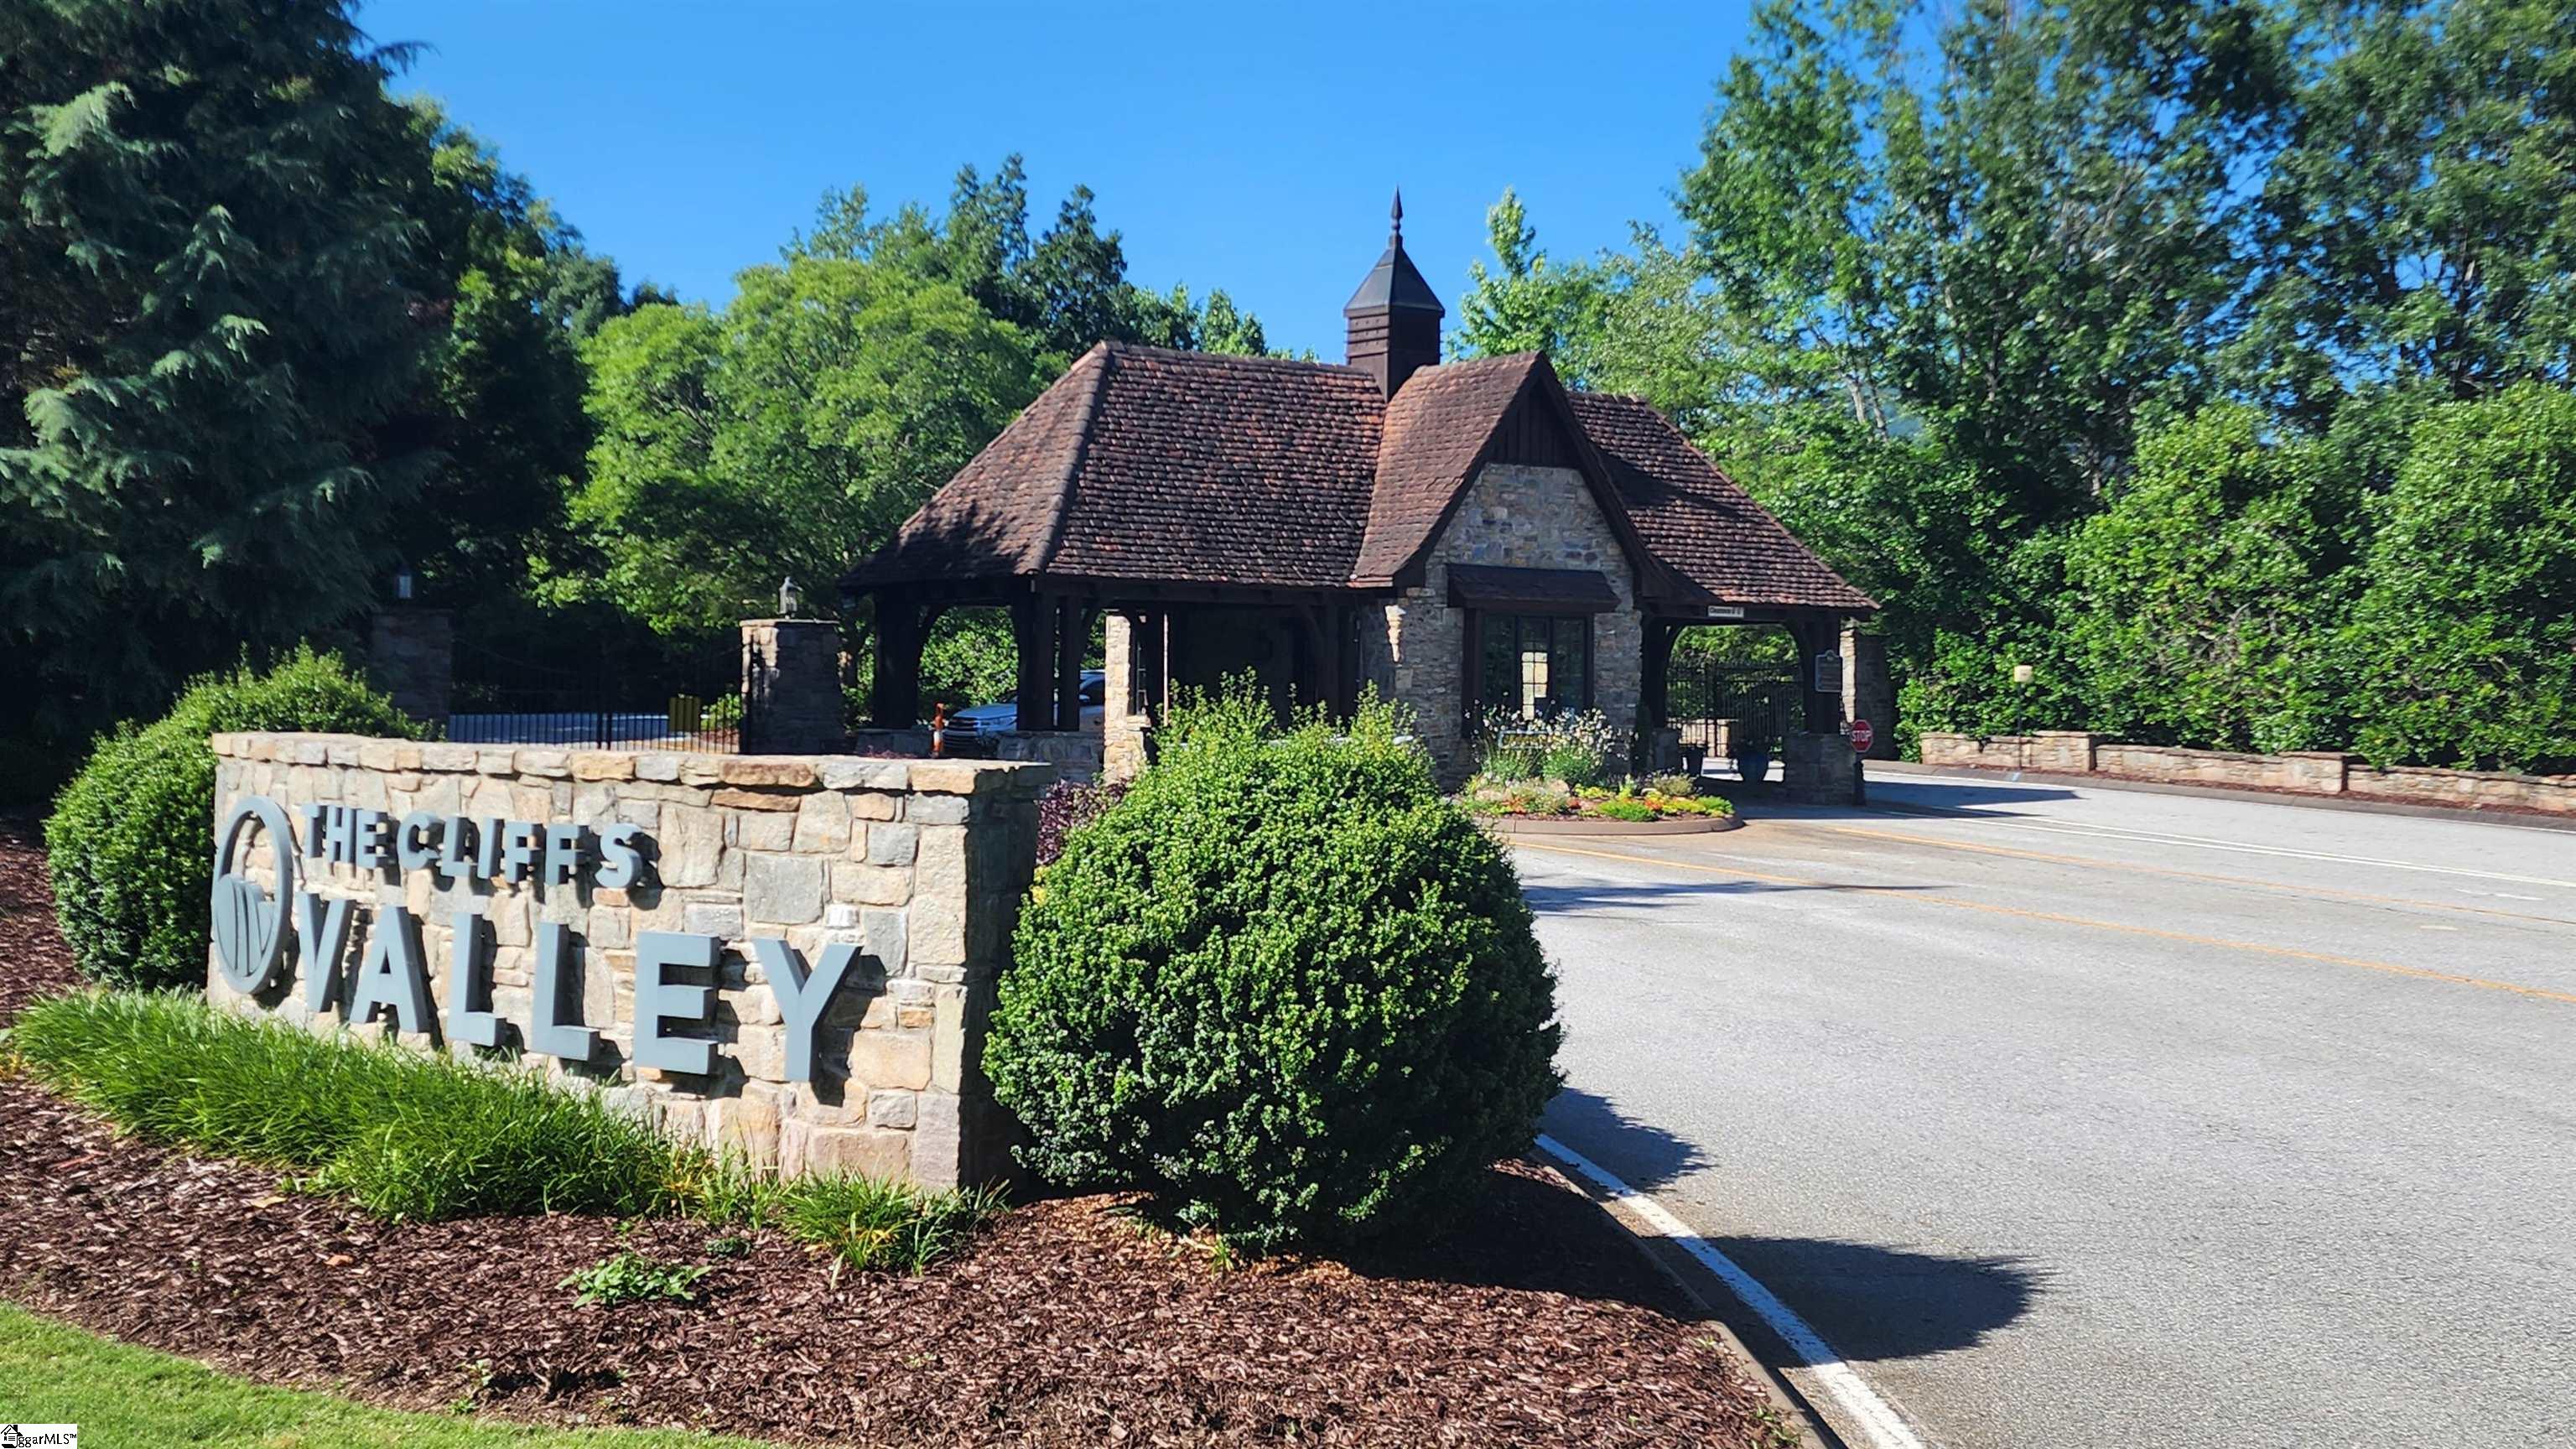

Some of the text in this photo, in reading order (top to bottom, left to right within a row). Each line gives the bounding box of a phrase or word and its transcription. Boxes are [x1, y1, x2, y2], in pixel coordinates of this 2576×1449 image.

[1852, 730, 1871, 742] STOP
[301, 803, 644, 888] THE CLIFFS
[297, 892, 864, 1082] VALLEY
